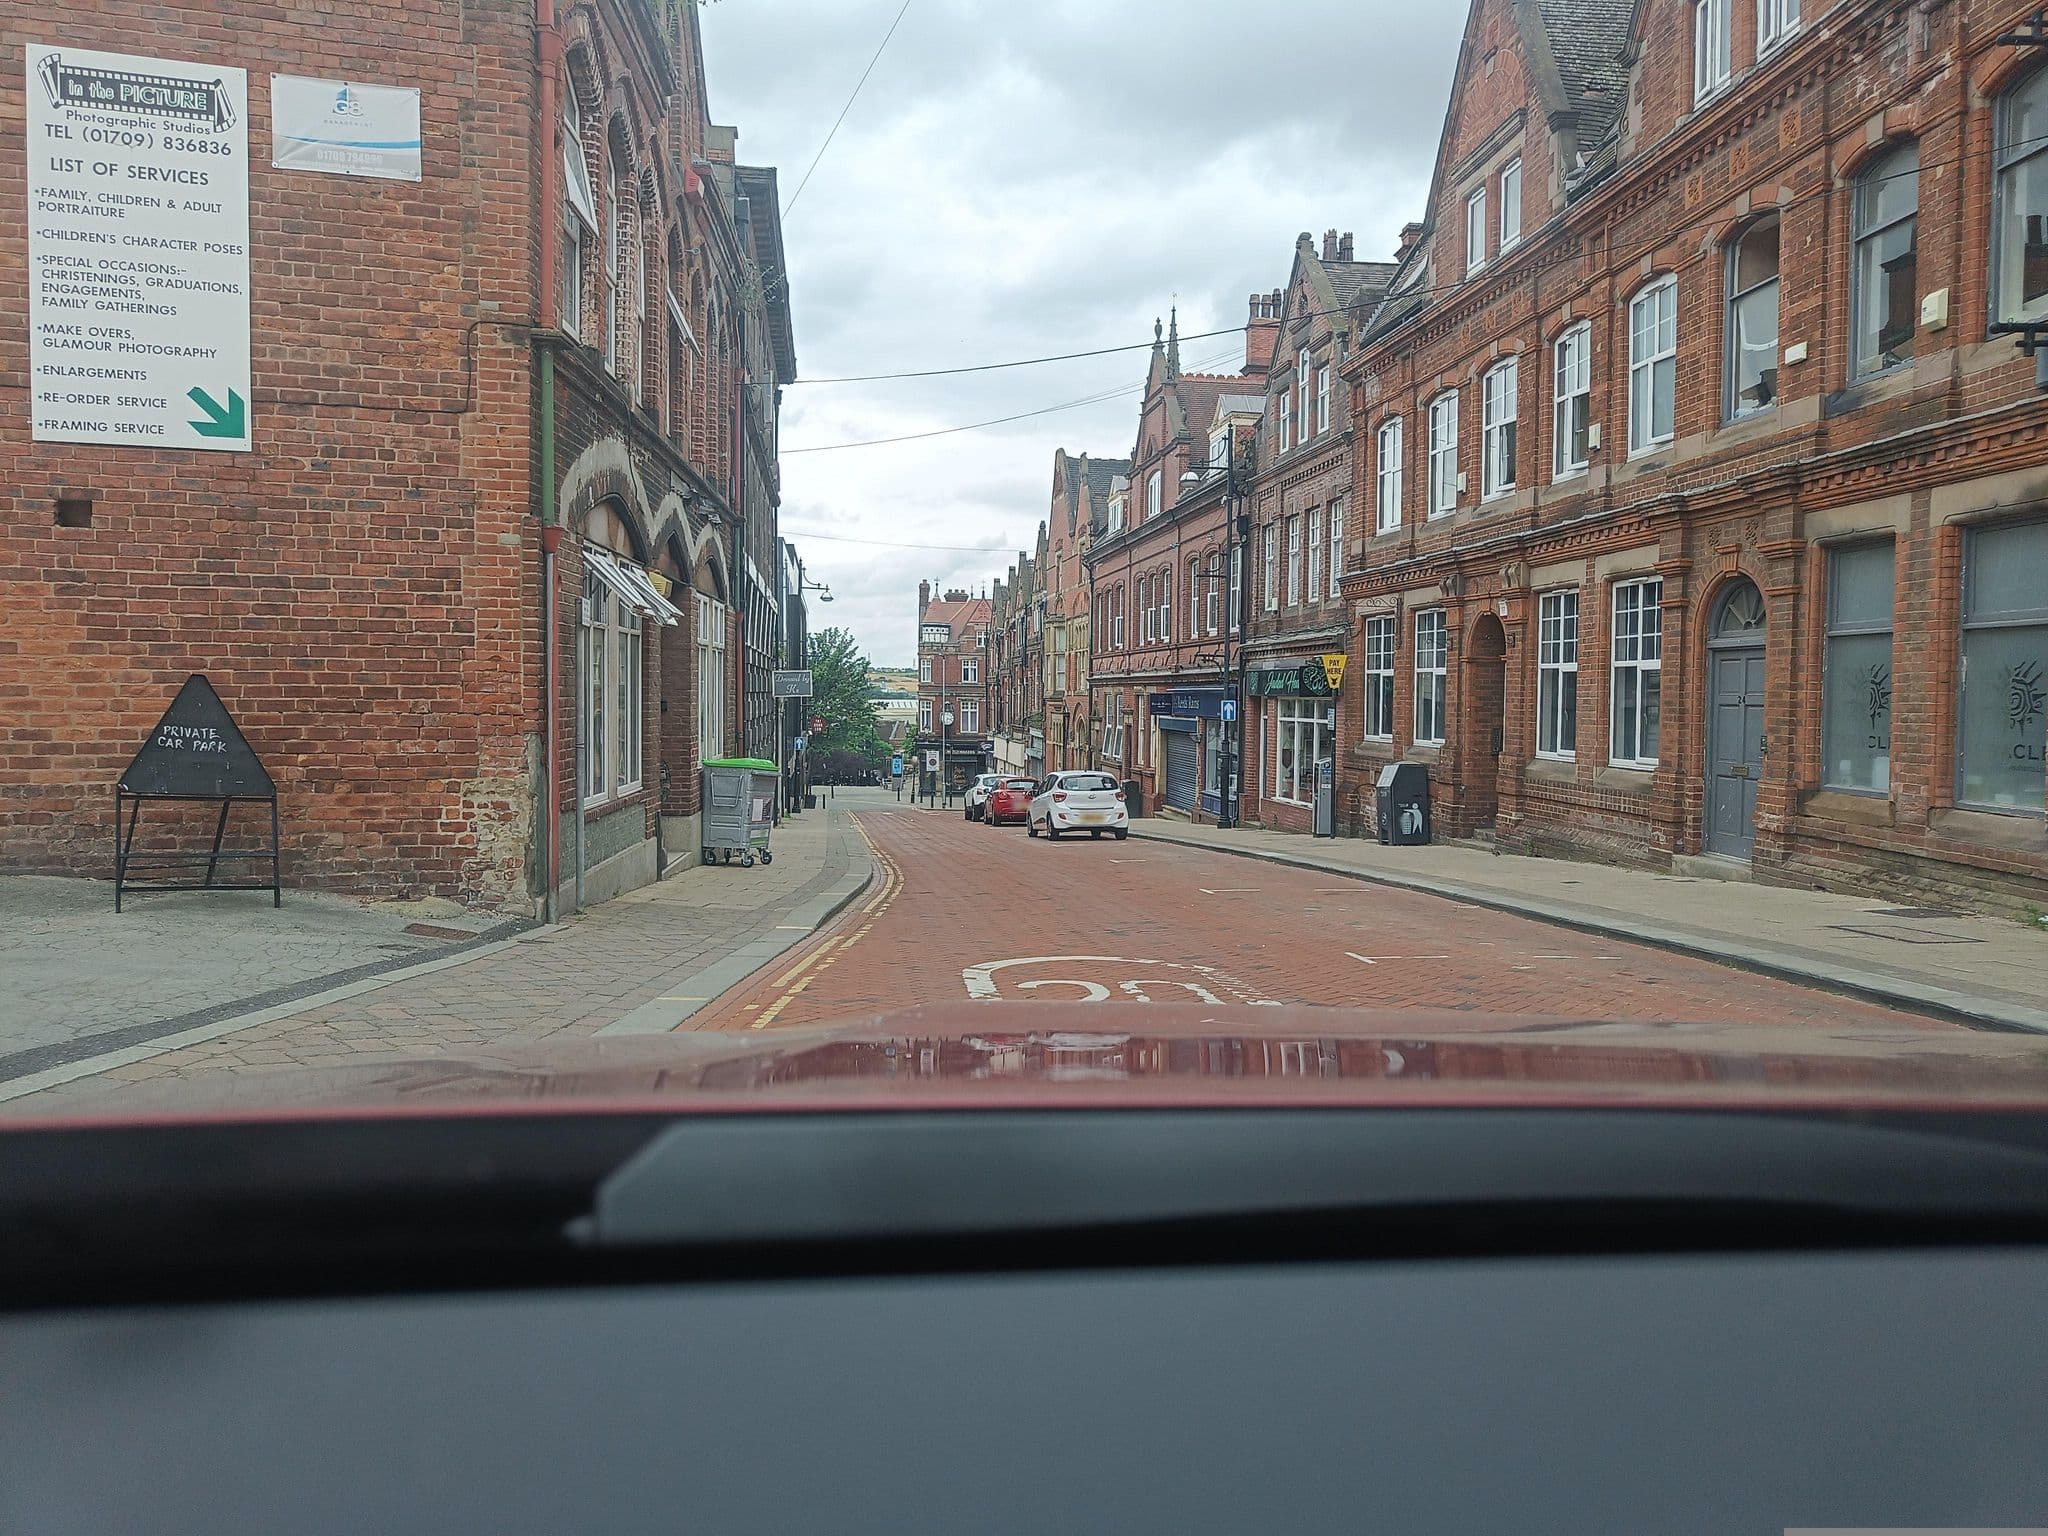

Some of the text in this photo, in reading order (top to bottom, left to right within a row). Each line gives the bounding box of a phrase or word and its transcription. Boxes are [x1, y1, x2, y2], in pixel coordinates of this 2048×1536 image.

[68, 80, 207, 111] in the PICTURE
[66, 109, 211, 135] Photographic Studios
[45, 123, 232, 156] TEL (01709) 836836
[50, 157, 209, 185] LIST OF SERVICES
[38, 201, 125, 218] PORTRAITURE
[40, 187, 222, 214] FAMILY, CHILDREN & ADULT
[42, 229, 243, 255] CHILDREN'S CHARACTER POSES
[41, 255, 187, 276] SPECIAL OCCASIONS:-
[41, 268, 243, 295] CHRISTENINGS, GRADUATIONS,
[41, 283, 145, 301] ENGAGEMENTS,
[42, 296, 177, 316] FAMILY GATHERINGS
[42, 324, 135, 341] MAKE OVERS,
[42, 338, 217, 359] GLAMOUR PHOTOGRAPHY
[42, 365, 147, 381] ENLARGEMENTS
[43, 392, 167, 408] RE-ORDER SERVICE
[44, 420, 165, 435] FRAMING SERVICE
[163, 725, 221, 740] PRIVATE
[157, 736, 227, 753] CAR PARK
